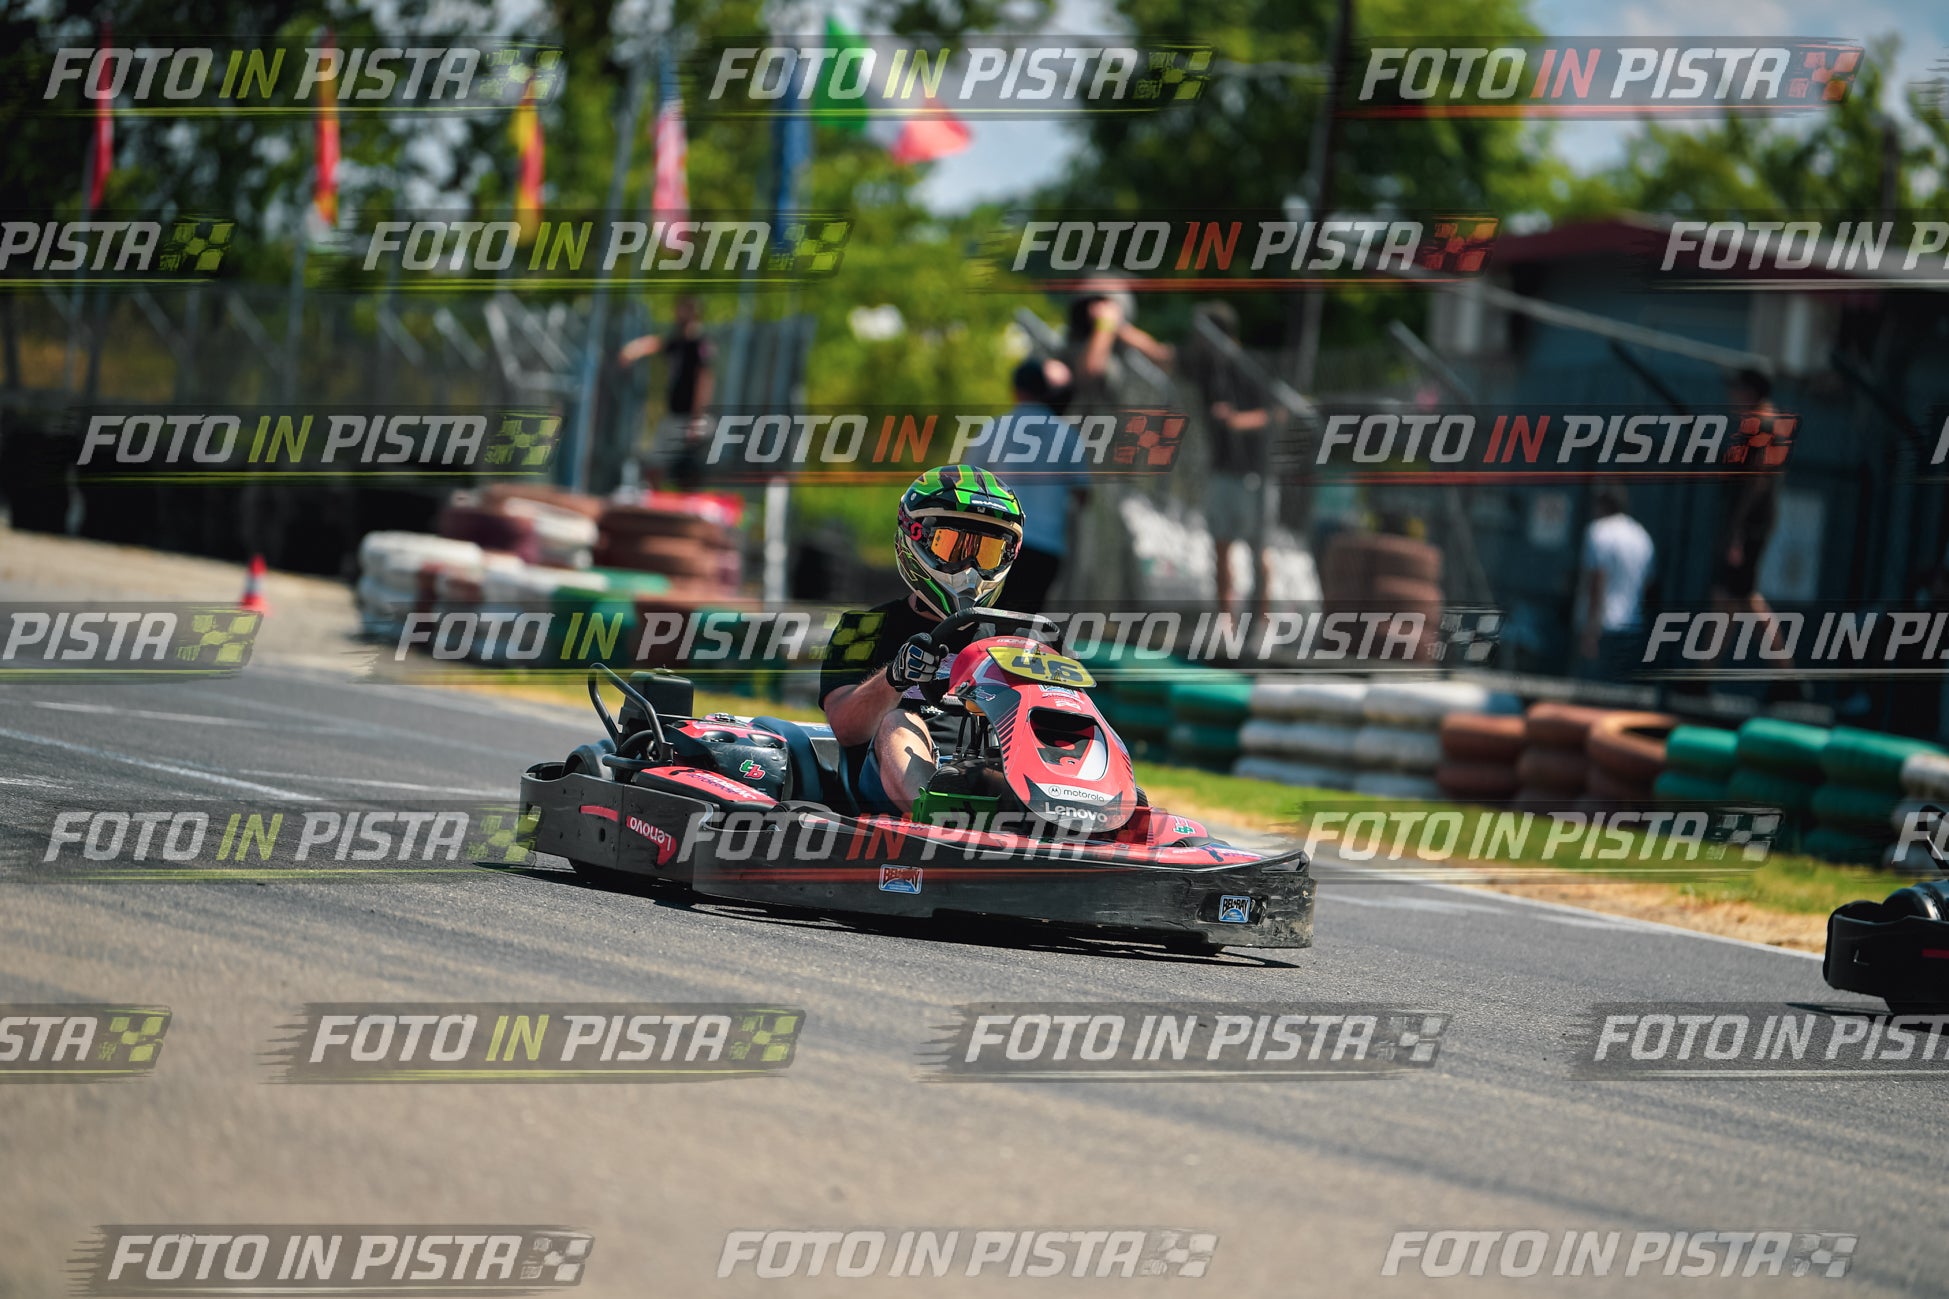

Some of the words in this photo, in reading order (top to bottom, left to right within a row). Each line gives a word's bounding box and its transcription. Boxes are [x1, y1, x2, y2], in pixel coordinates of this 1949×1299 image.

[1011, 656, 1083, 682] 46
[1063, 788, 1105, 803] motorola
[1045, 802, 1108, 823] Lenovo
[630, 816, 671, 852] Lenovo
